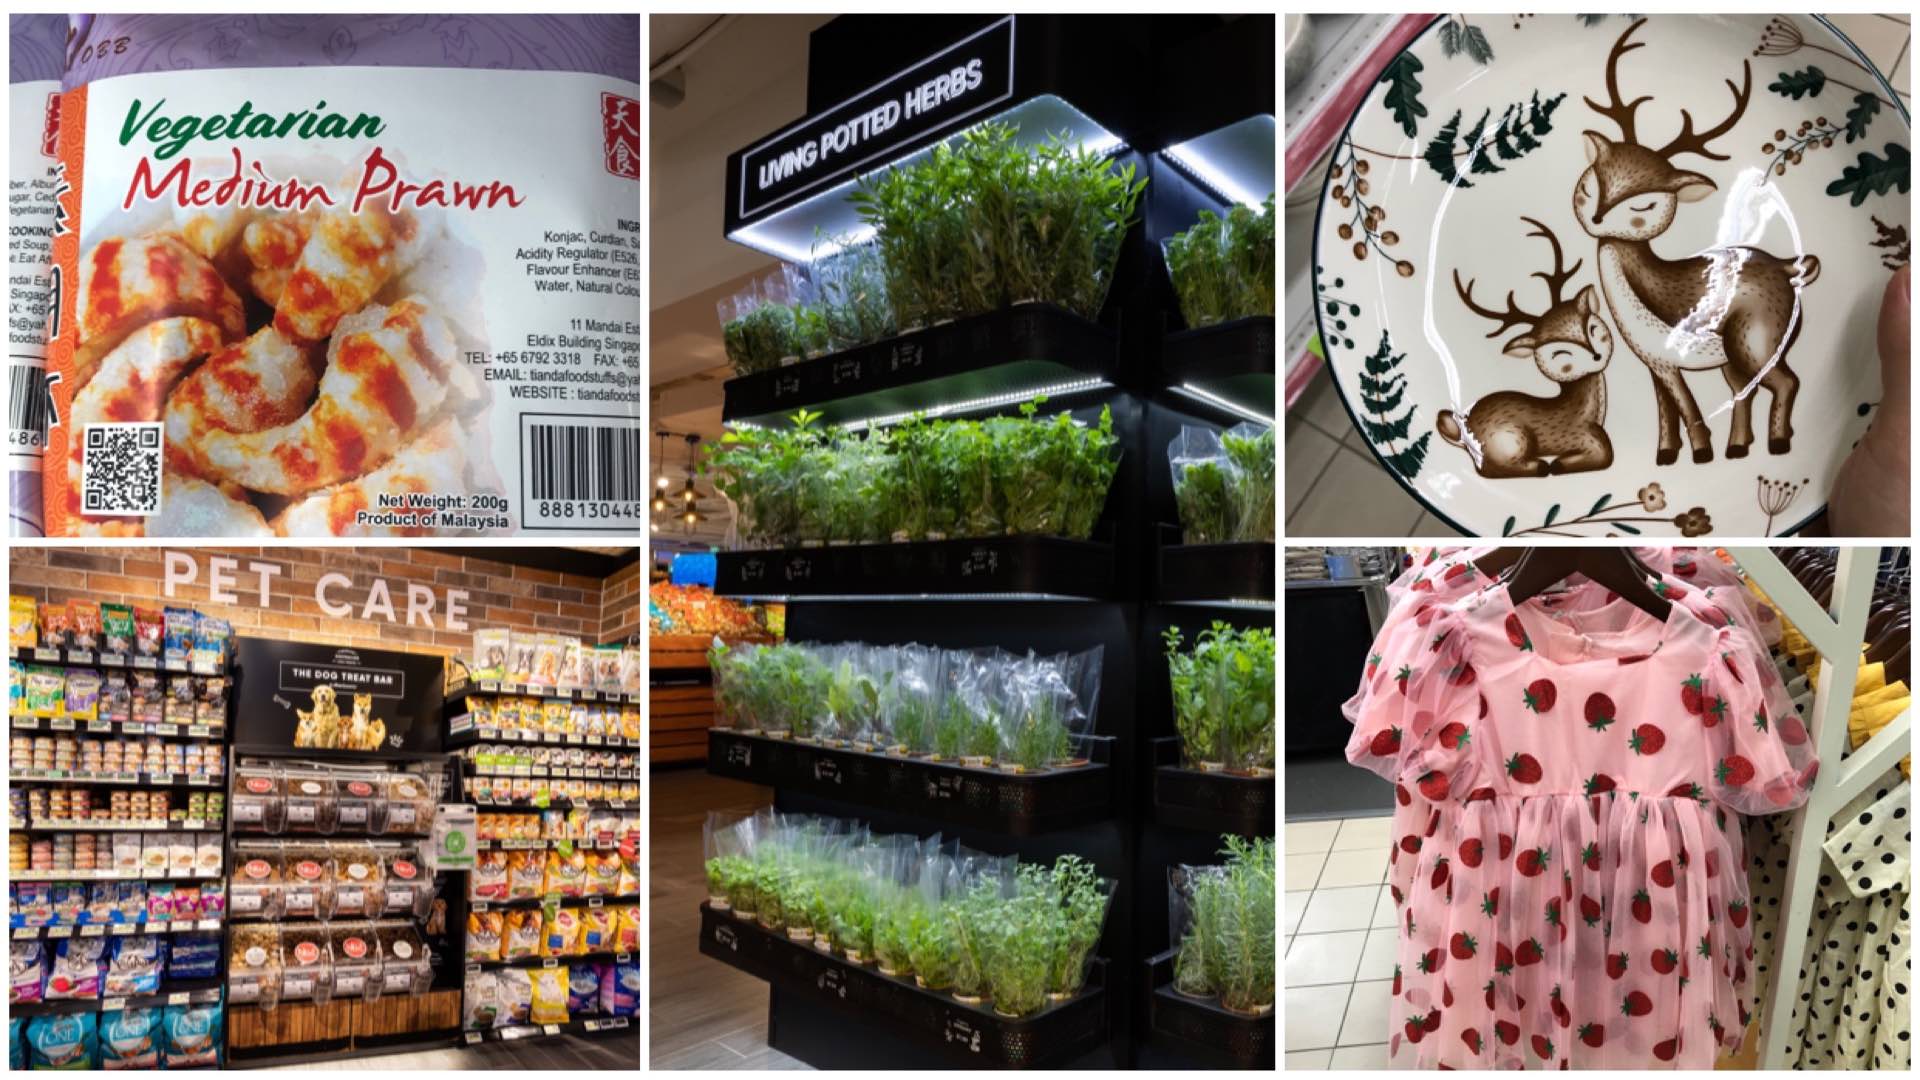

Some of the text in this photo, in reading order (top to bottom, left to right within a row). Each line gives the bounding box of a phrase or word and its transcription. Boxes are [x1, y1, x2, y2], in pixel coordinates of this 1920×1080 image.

[118, 97, 387, 160] Vegetarian
[758, 58, 983, 190] LIVING POTTED HERBS
[122, 147, 337, 210] Medium
[351, 146, 528, 213] Prawn
[544, 230, 587, 245] Konjac,
[515, 247, 554, 261] Acidity
[556, 246, 608, 261] Regulator
[526, 263, 570, 276] Flavour
[573, 263, 621, 278] Enhancer
[534, 279, 573, 293] Water,
[576, 280, 613, 294] Natural
[571, 319, 581, 331] 11
[585, 319, 623, 333] Mandai
[527, 334, 556, 347] Eldix
[559, 335, 602, 351] Building
[464, 352, 493, 365] TEL:
[495, 352, 518, 365] +65
[520, 352, 550, 365] 6792
[552, 352, 581, 365] 3318
[593, 353, 619, 367] FAX:
[483, 368, 527, 381] EMAIL:
[509, 386, 568, 400] WEBSITE
[378, 494, 509, 513] Net Weight: 200g
[357, 512, 509, 530] Product of Malaysia
[164, 551, 470, 631] PET CARE
[292, 668, 394, 685] THE DOG TREAT BAR
